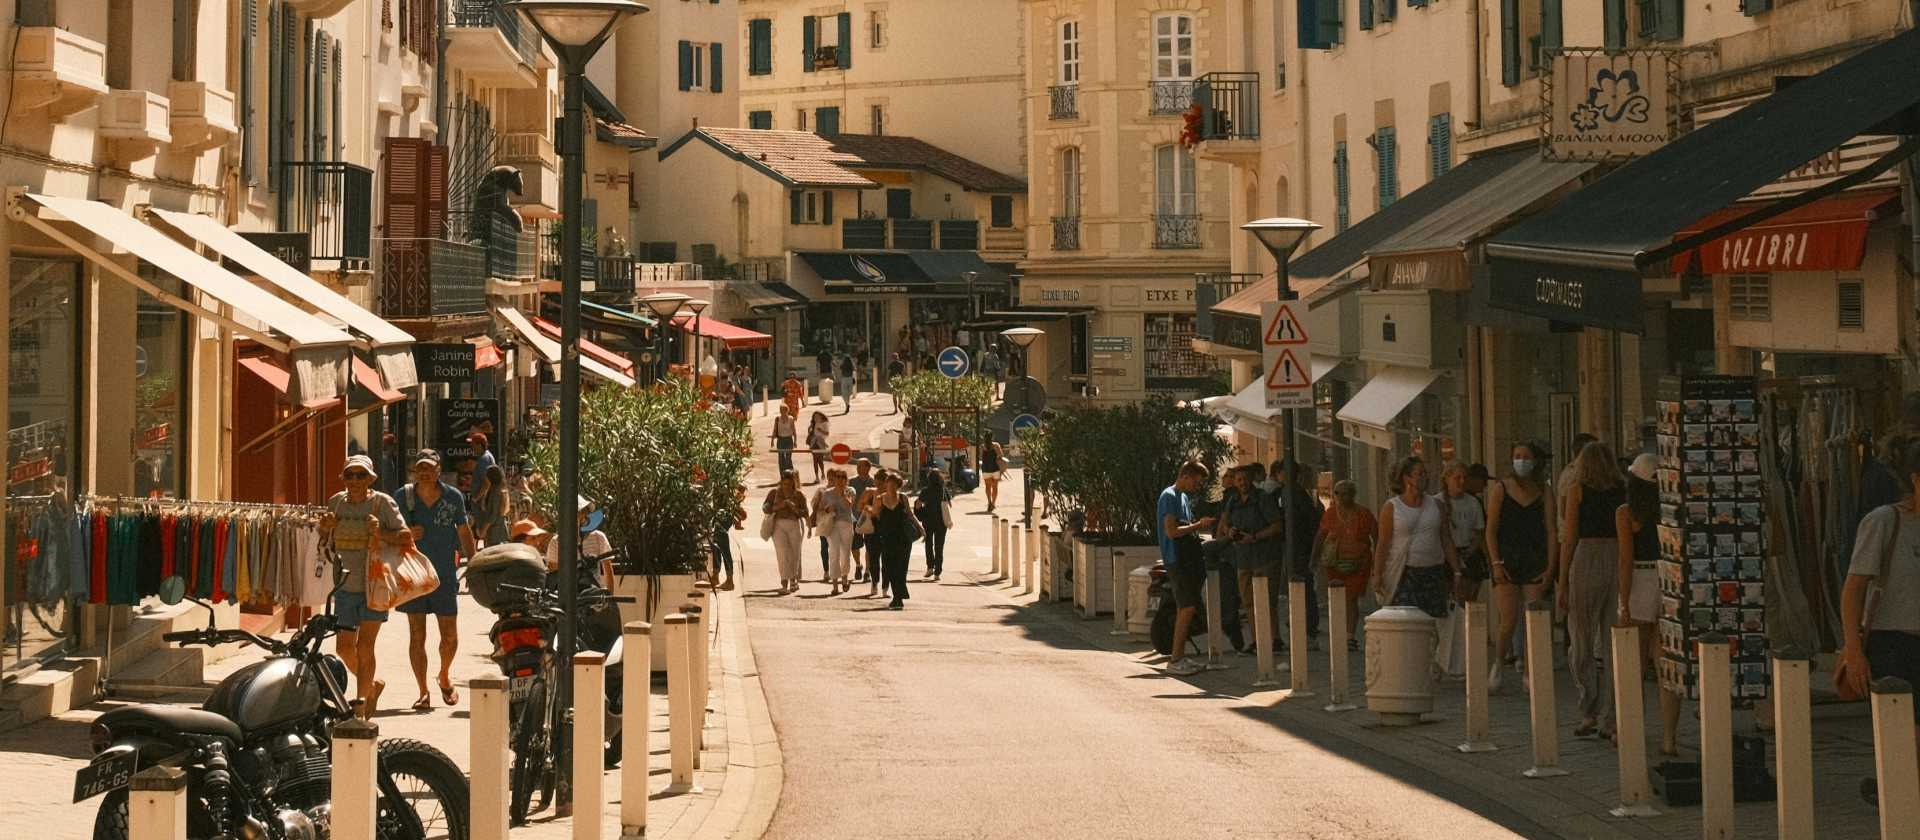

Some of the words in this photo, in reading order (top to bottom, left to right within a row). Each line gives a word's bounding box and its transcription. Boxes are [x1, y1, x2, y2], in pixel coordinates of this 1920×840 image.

[1553, 133, 1613, 143] BANANA
[1616, 133, 1667, 143] MOON
[1722, 232, 1808, 271] COLIBRI
[1146, 289, 1179, 301] ETXE
[431, 349, 473, 361] Janine
[434, 365, 470, 377] Robin
